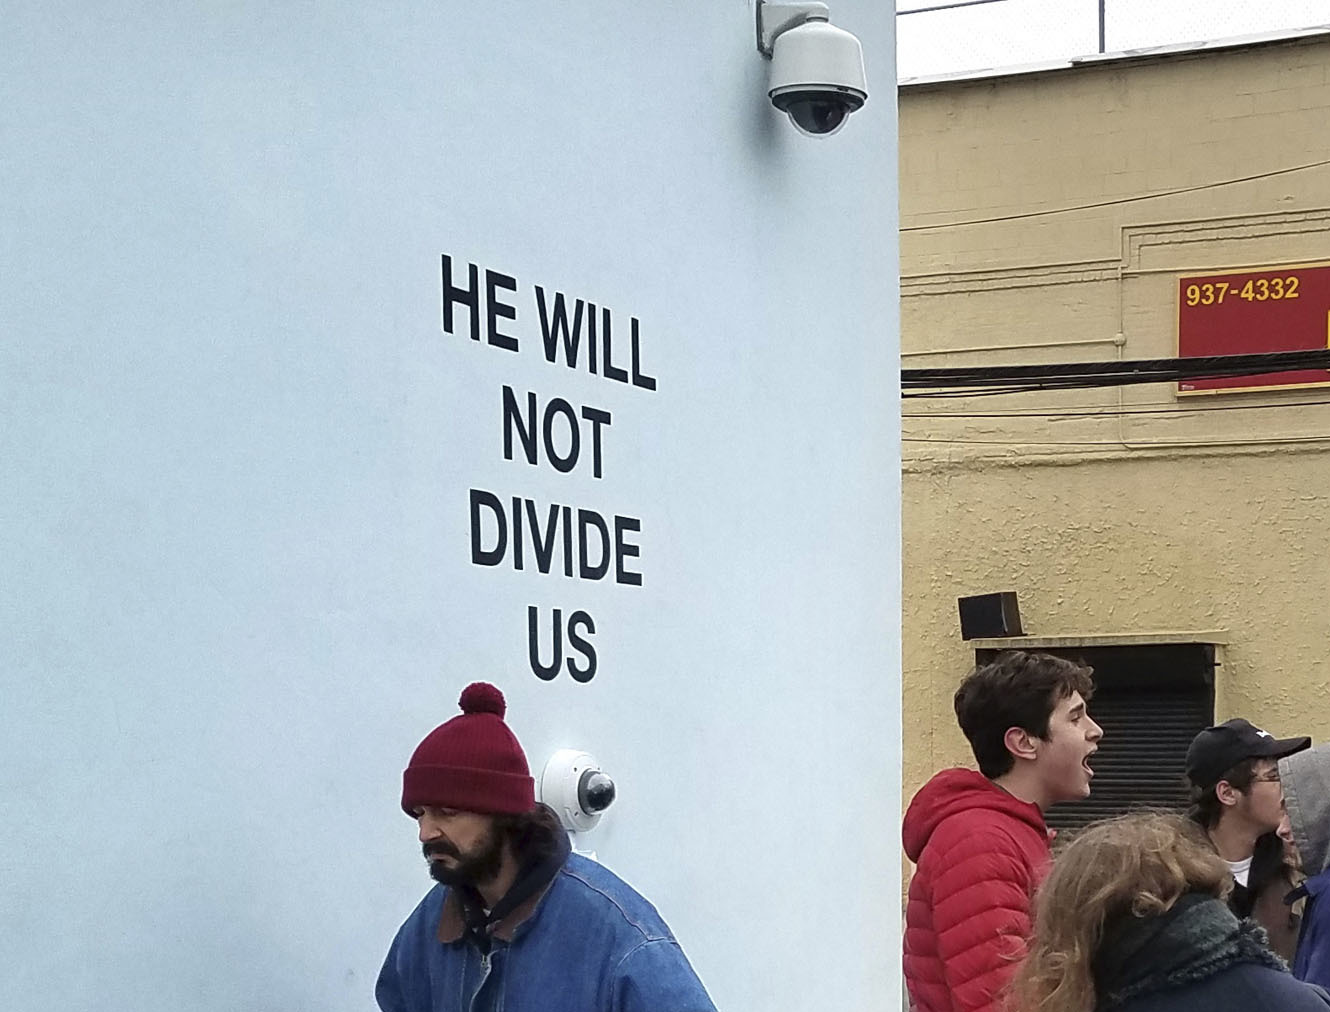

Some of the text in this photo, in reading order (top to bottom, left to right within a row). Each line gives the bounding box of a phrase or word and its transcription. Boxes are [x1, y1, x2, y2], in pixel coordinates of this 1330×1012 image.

[441, 253, 657, 392] HE WILL
[1185, 276, 1301, 307] 937-4332
[502, 384, 612, 480] NOT
[469, 488, 643, 587] DIVIDE
[527, 605, 598, 684] US
